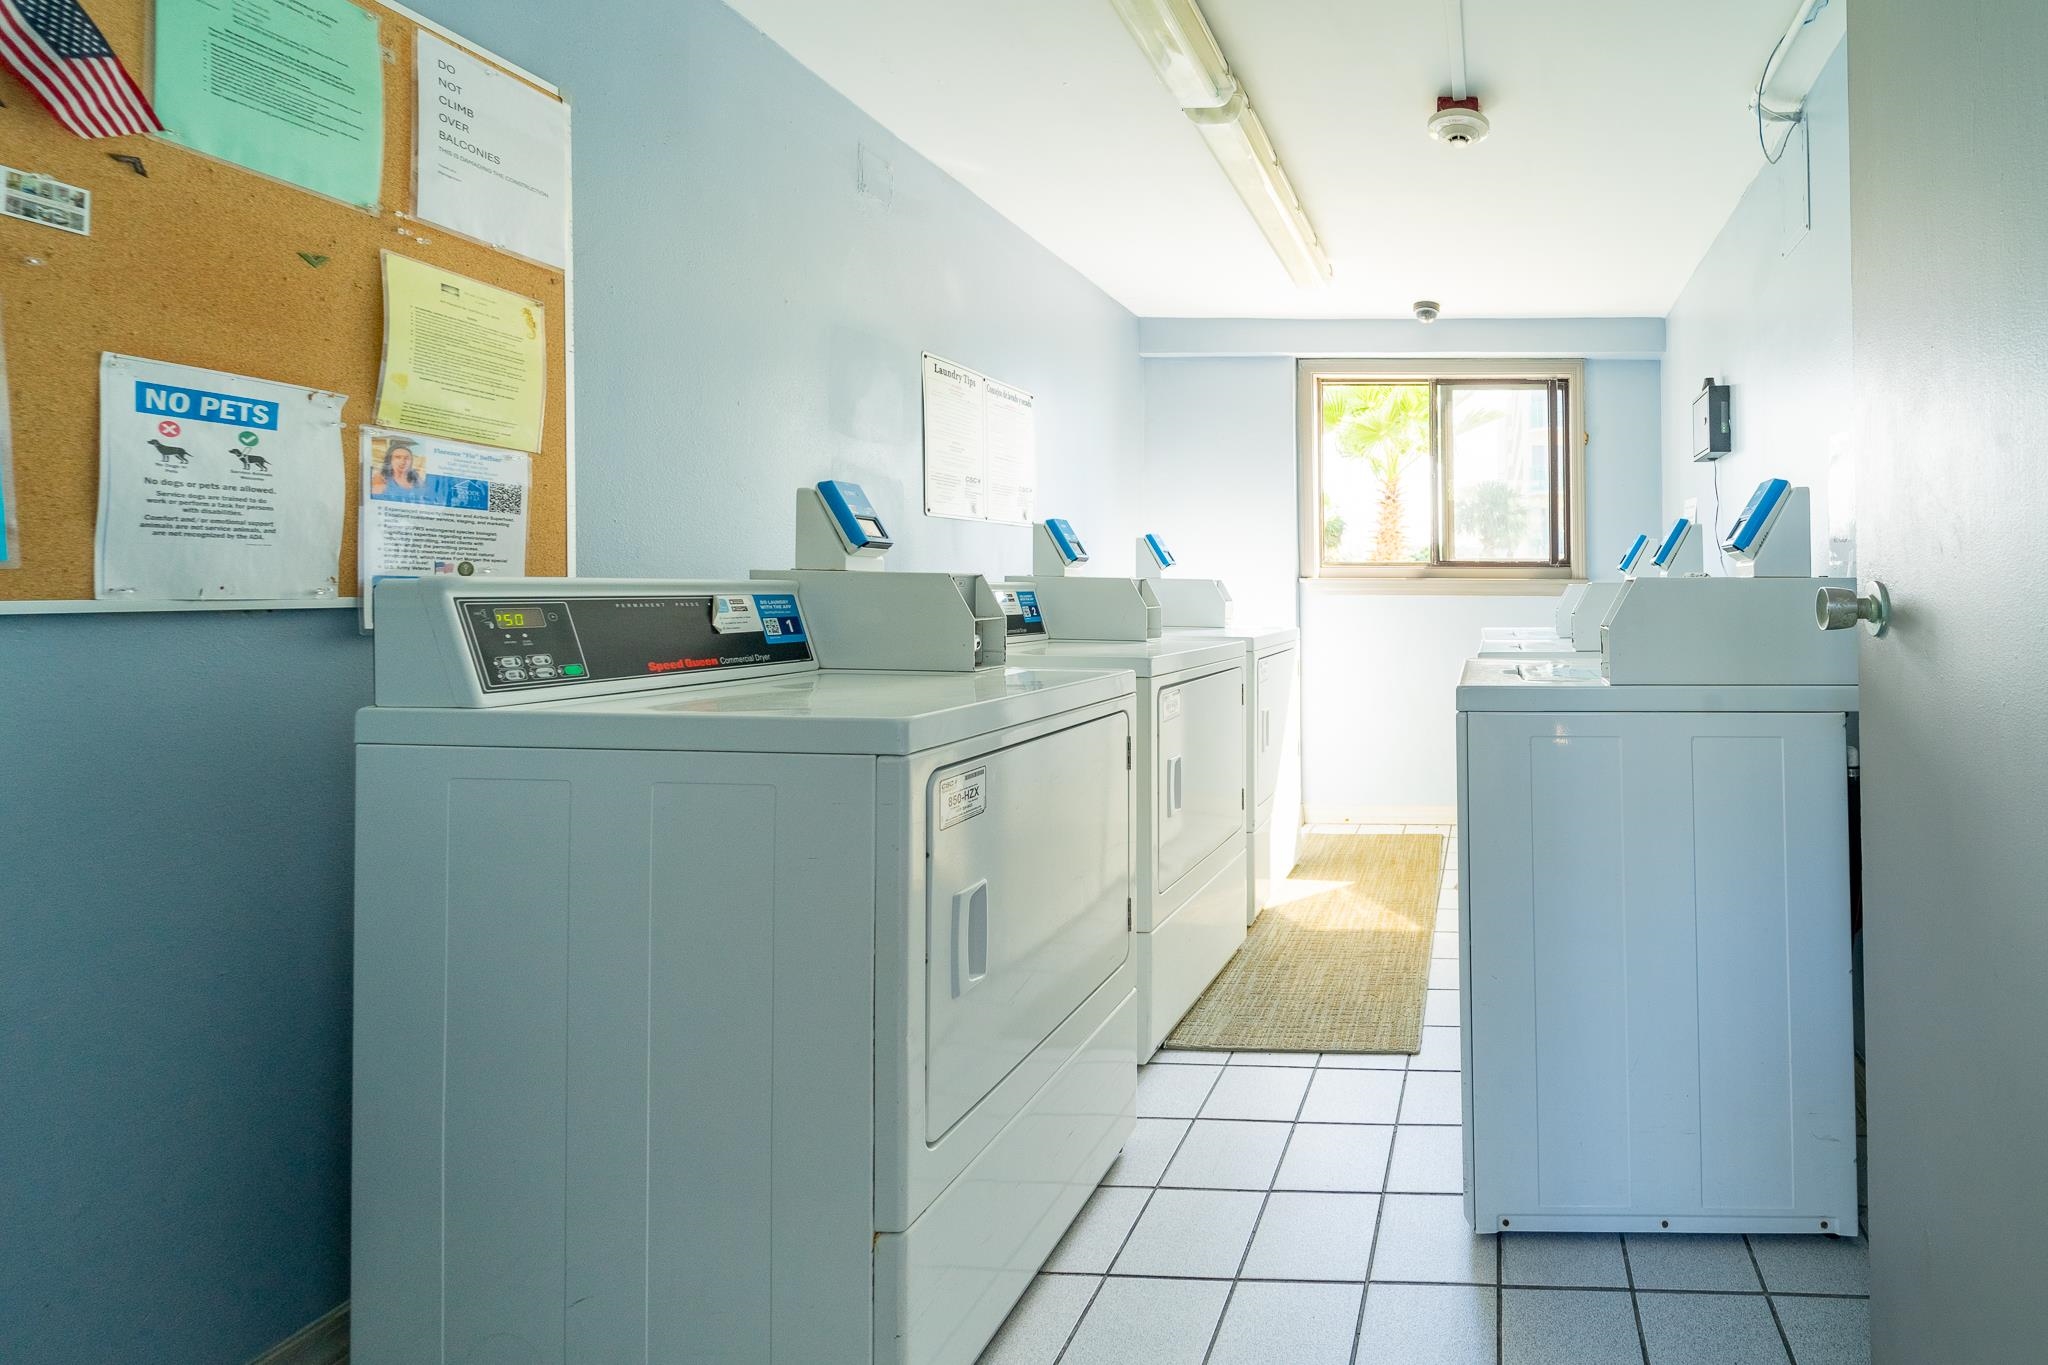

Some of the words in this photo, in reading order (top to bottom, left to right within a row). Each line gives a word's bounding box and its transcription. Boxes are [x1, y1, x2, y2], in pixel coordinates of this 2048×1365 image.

[437, 59, 456, 75] DO
[438, 77, 463, 95] NOT
[438, 95, 475, 119] CLIMB
[438, 113, 470, 134] OVER
[438, 130, 501, 165] BALCONIES
[933, 363, 963, 384] Laundry
[963, 374, 976, 388] Tips
[145, 388, 190, 414] NO
[199, 396, 270, 425] PETS
[144, 477, 159, 485] No
[161, 479, 185, 488] dogs
[239, 485, 277, 494] allowed.
[144, 514, 178, 522] Comfort
[1031, 607, 1038, 616] 2
[785, 619, 794, 633] 1
[647, 659, 684, 672] Speed
[684, 657, 718, 668] Queen
[719, 655, 754, 665] Commercial
[754, 653, 771, 663] Dryer
[948, 786, 980, 808] 850-HZX
